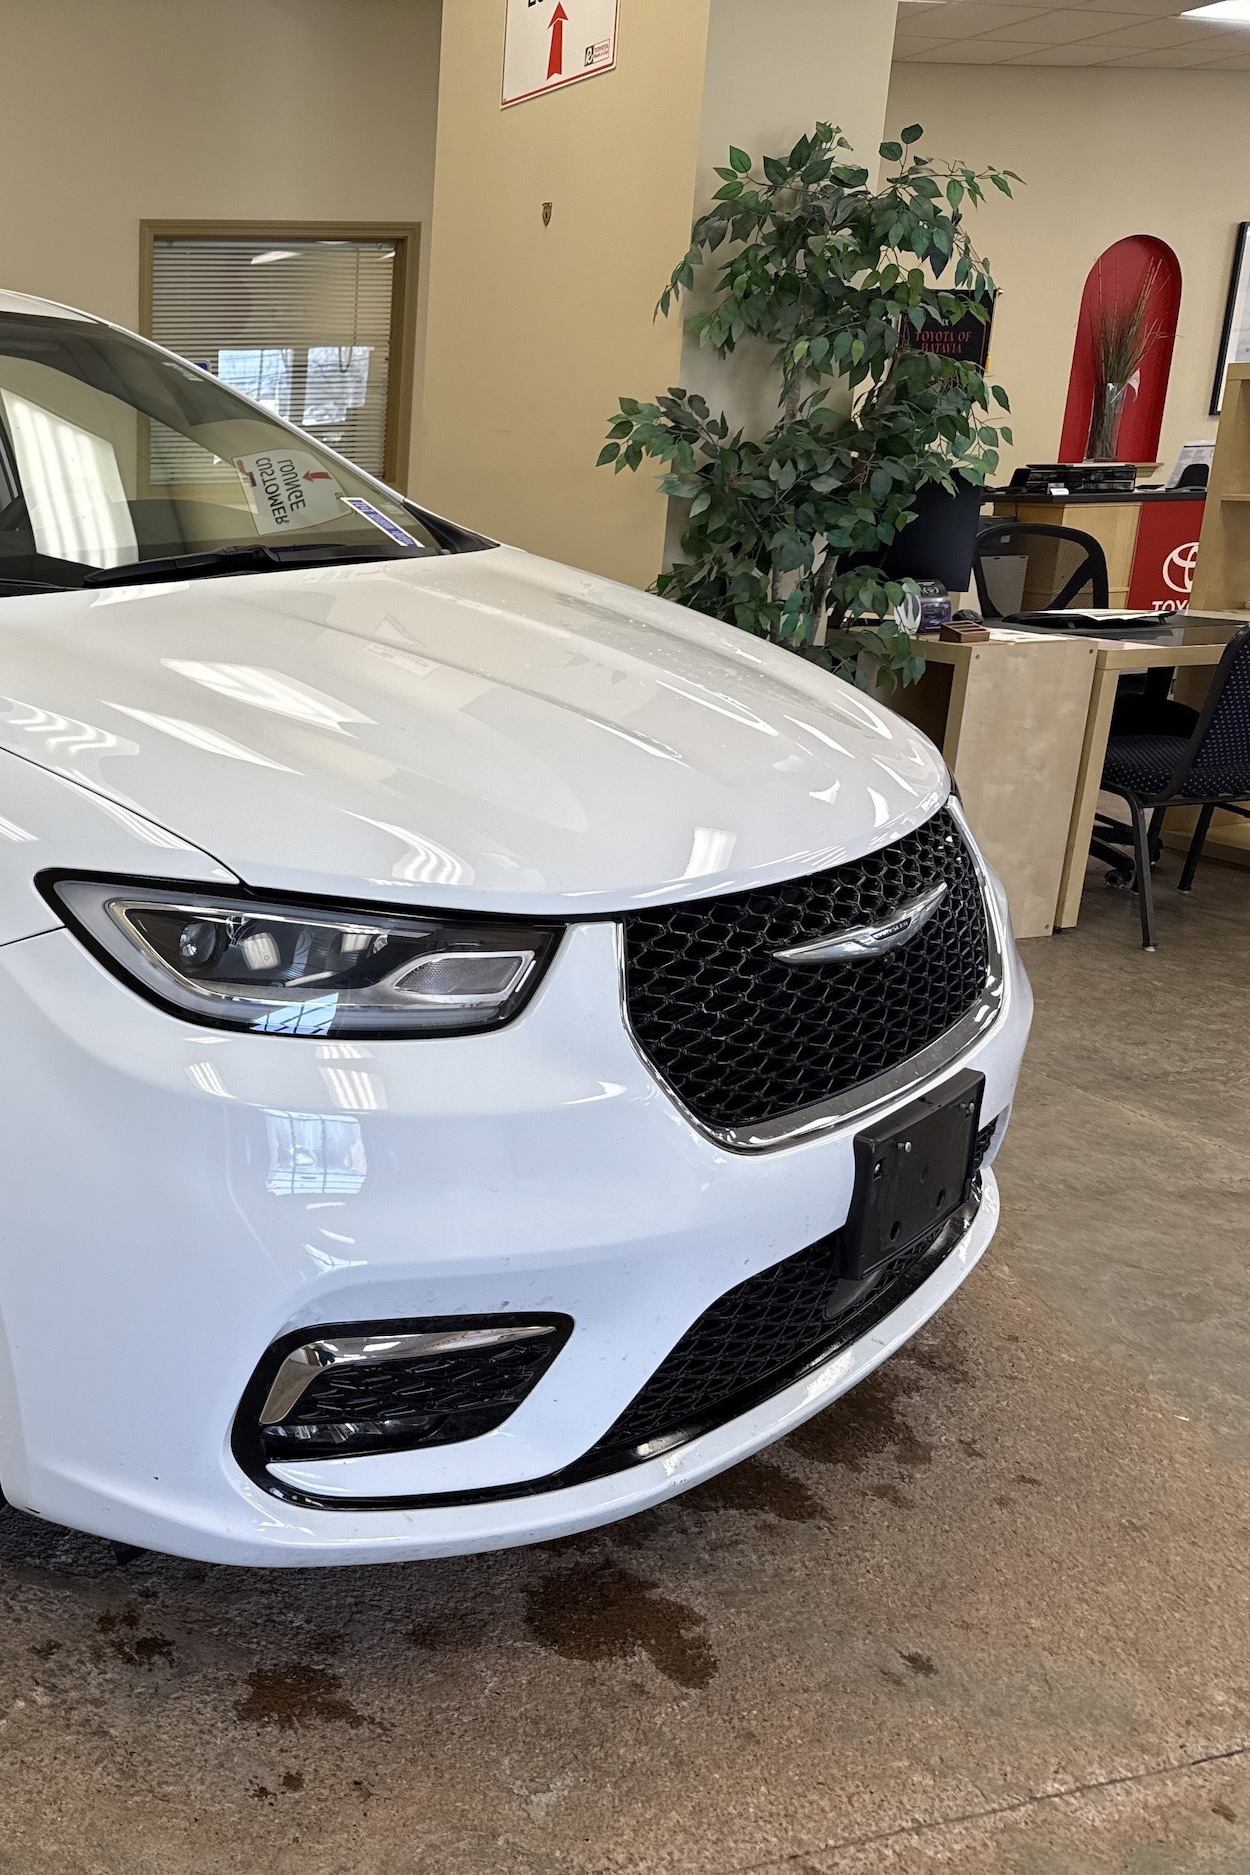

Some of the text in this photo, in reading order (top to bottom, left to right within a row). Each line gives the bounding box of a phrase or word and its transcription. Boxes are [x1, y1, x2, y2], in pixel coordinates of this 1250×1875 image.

[914, 331, 972, 342] TOYOTA OF
[921, 342, 962, 353] BATAVIA
[1152, 599, 1190, 611] TOY
